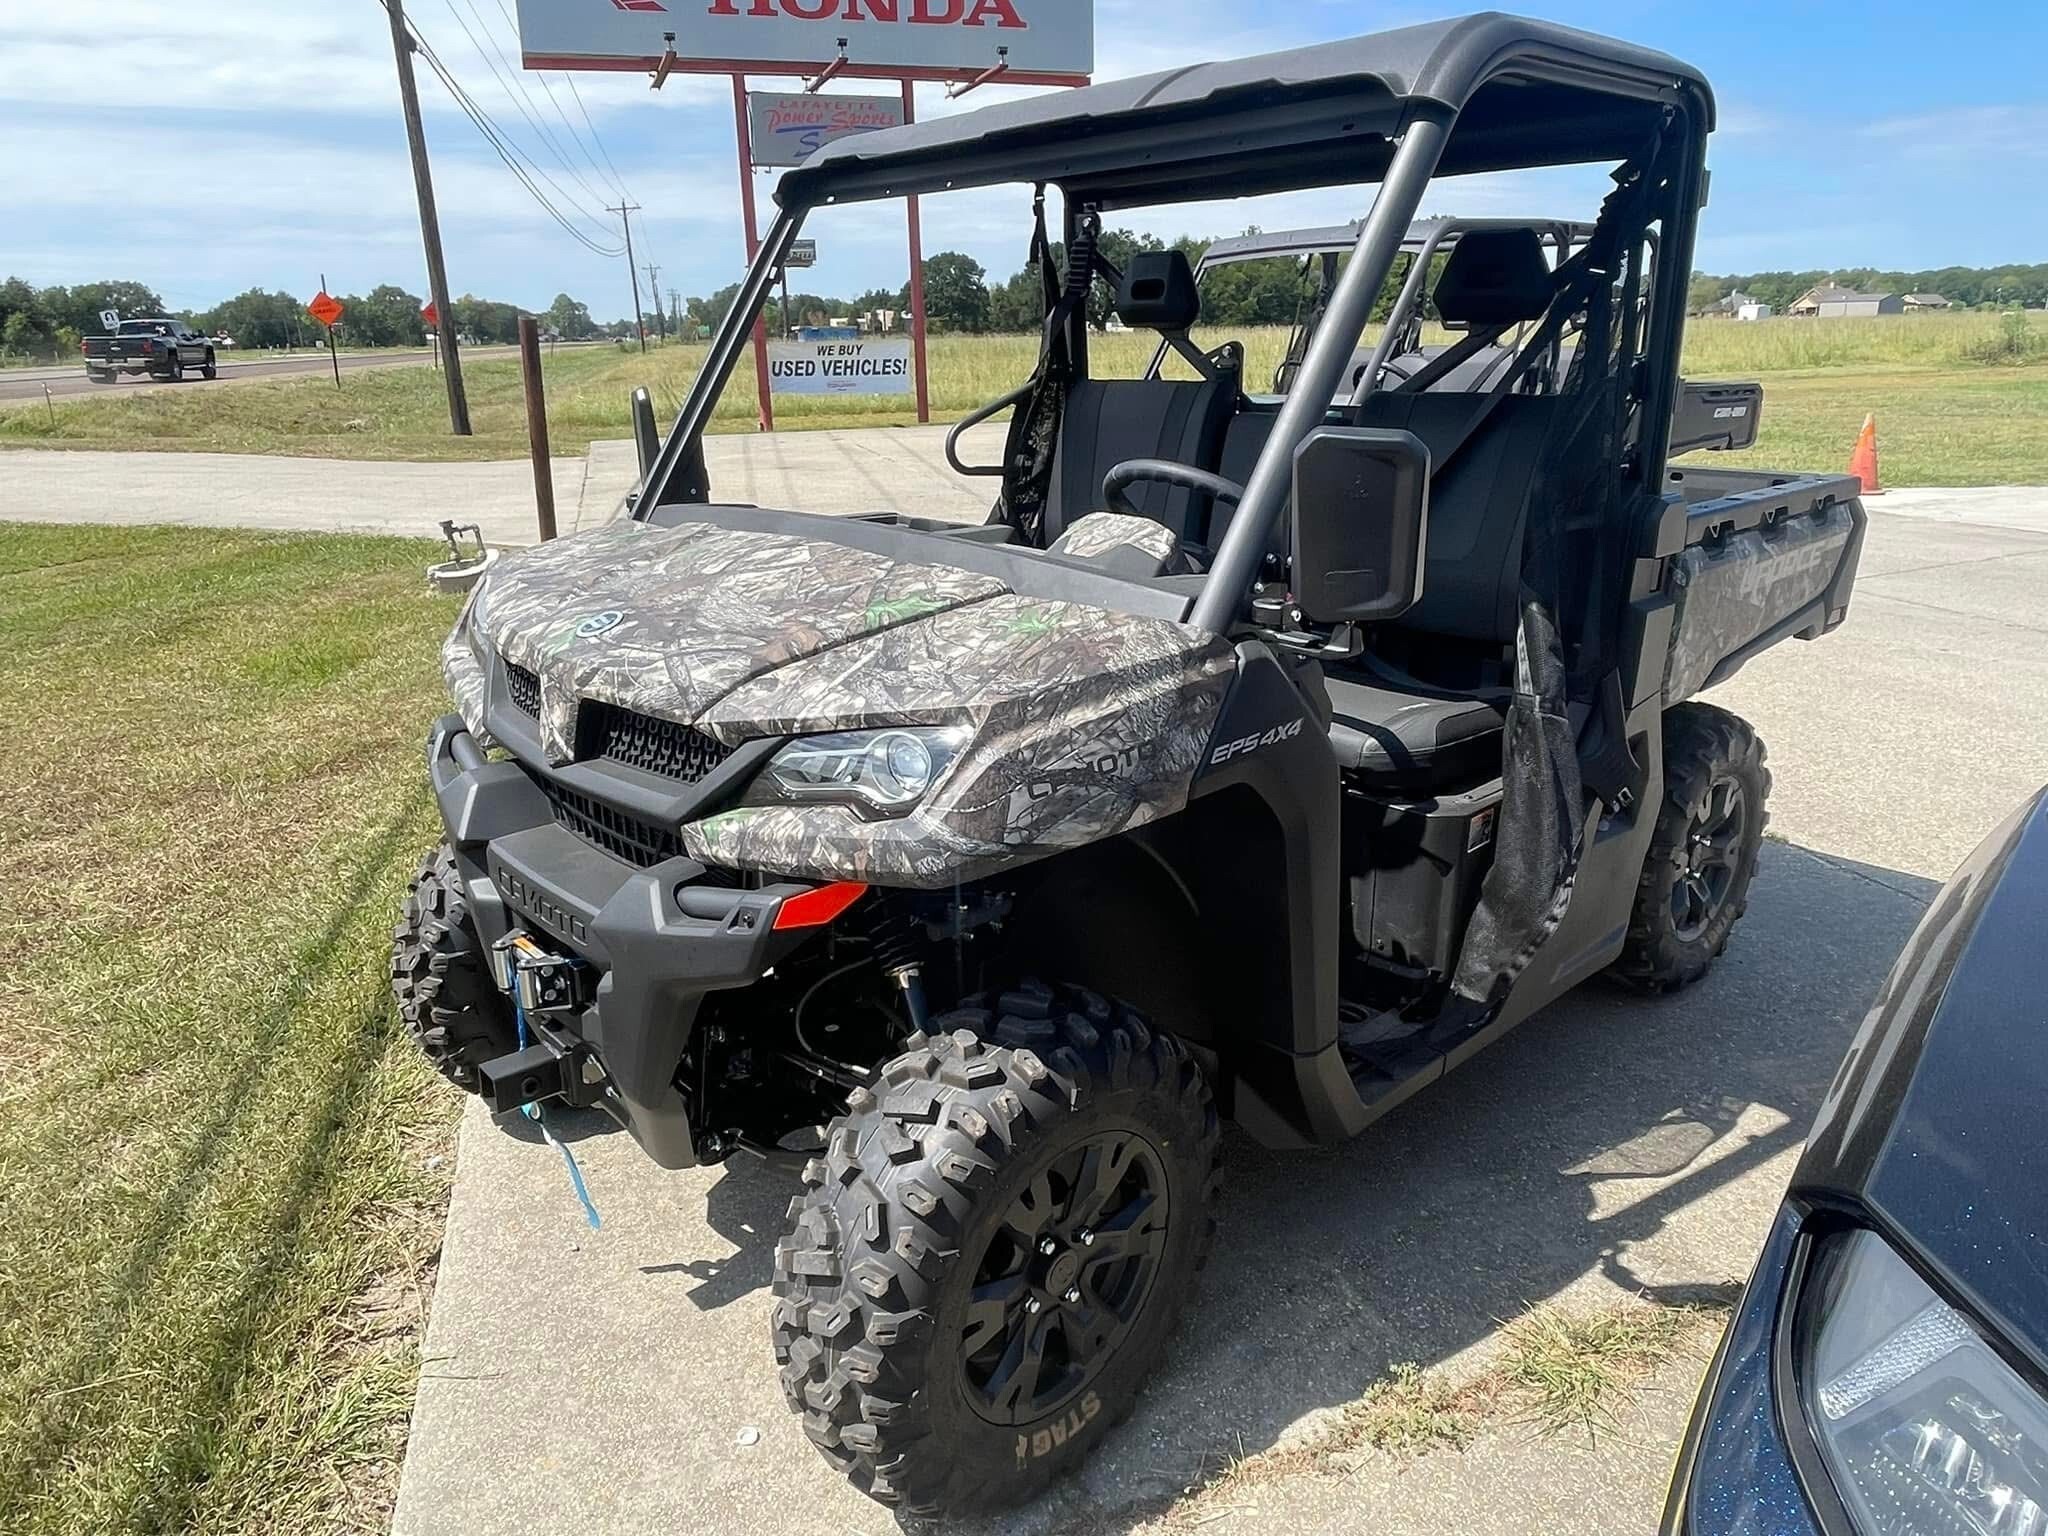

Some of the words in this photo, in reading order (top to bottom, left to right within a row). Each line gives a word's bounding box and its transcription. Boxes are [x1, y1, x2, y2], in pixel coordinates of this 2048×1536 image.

[817, 345, 836, 356] WE
[838, 344, 863, 356] BUY
[772, 360, 816, 377] USED
[822, 358, 908, 377] VEHICLES!
[1032, 1390, 1101, 1457] STAG
